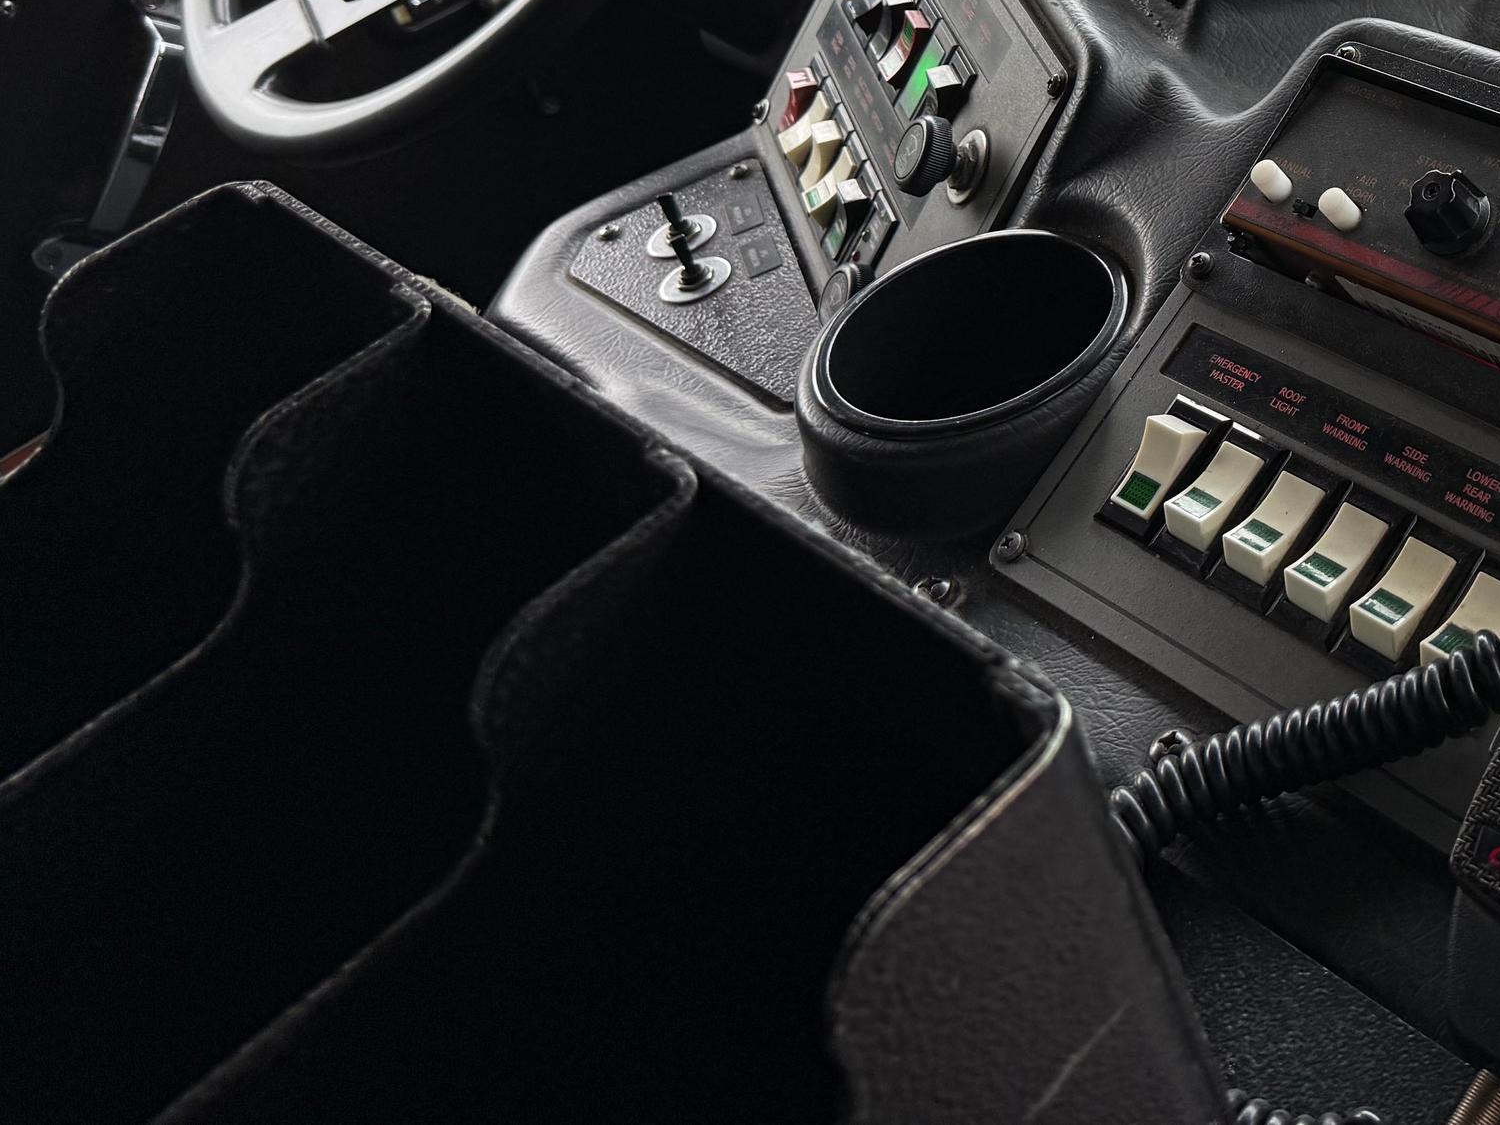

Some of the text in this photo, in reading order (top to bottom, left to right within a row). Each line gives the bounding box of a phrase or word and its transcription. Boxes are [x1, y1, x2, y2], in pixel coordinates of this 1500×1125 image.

[1359, 175, 1377, 188] AIR
[1209, 354, 1262, 383] EMERGENCY
[1210, 369, 1245, 392] MASTER
[1279, 386, 1307, 405] ROOF
[1269, 397, 1300, 419] LIGHT
[1337, 413, 1370, 434] FRONT
[1321, 421, 1368, 453] WARNING
[1402, 444, 1430, 465] SIDE
[1383, 451, 1433, 484] WARNING
[1462, 482, 1493, 506] REAR
[1444, 491, 1494, 524] WARNING
